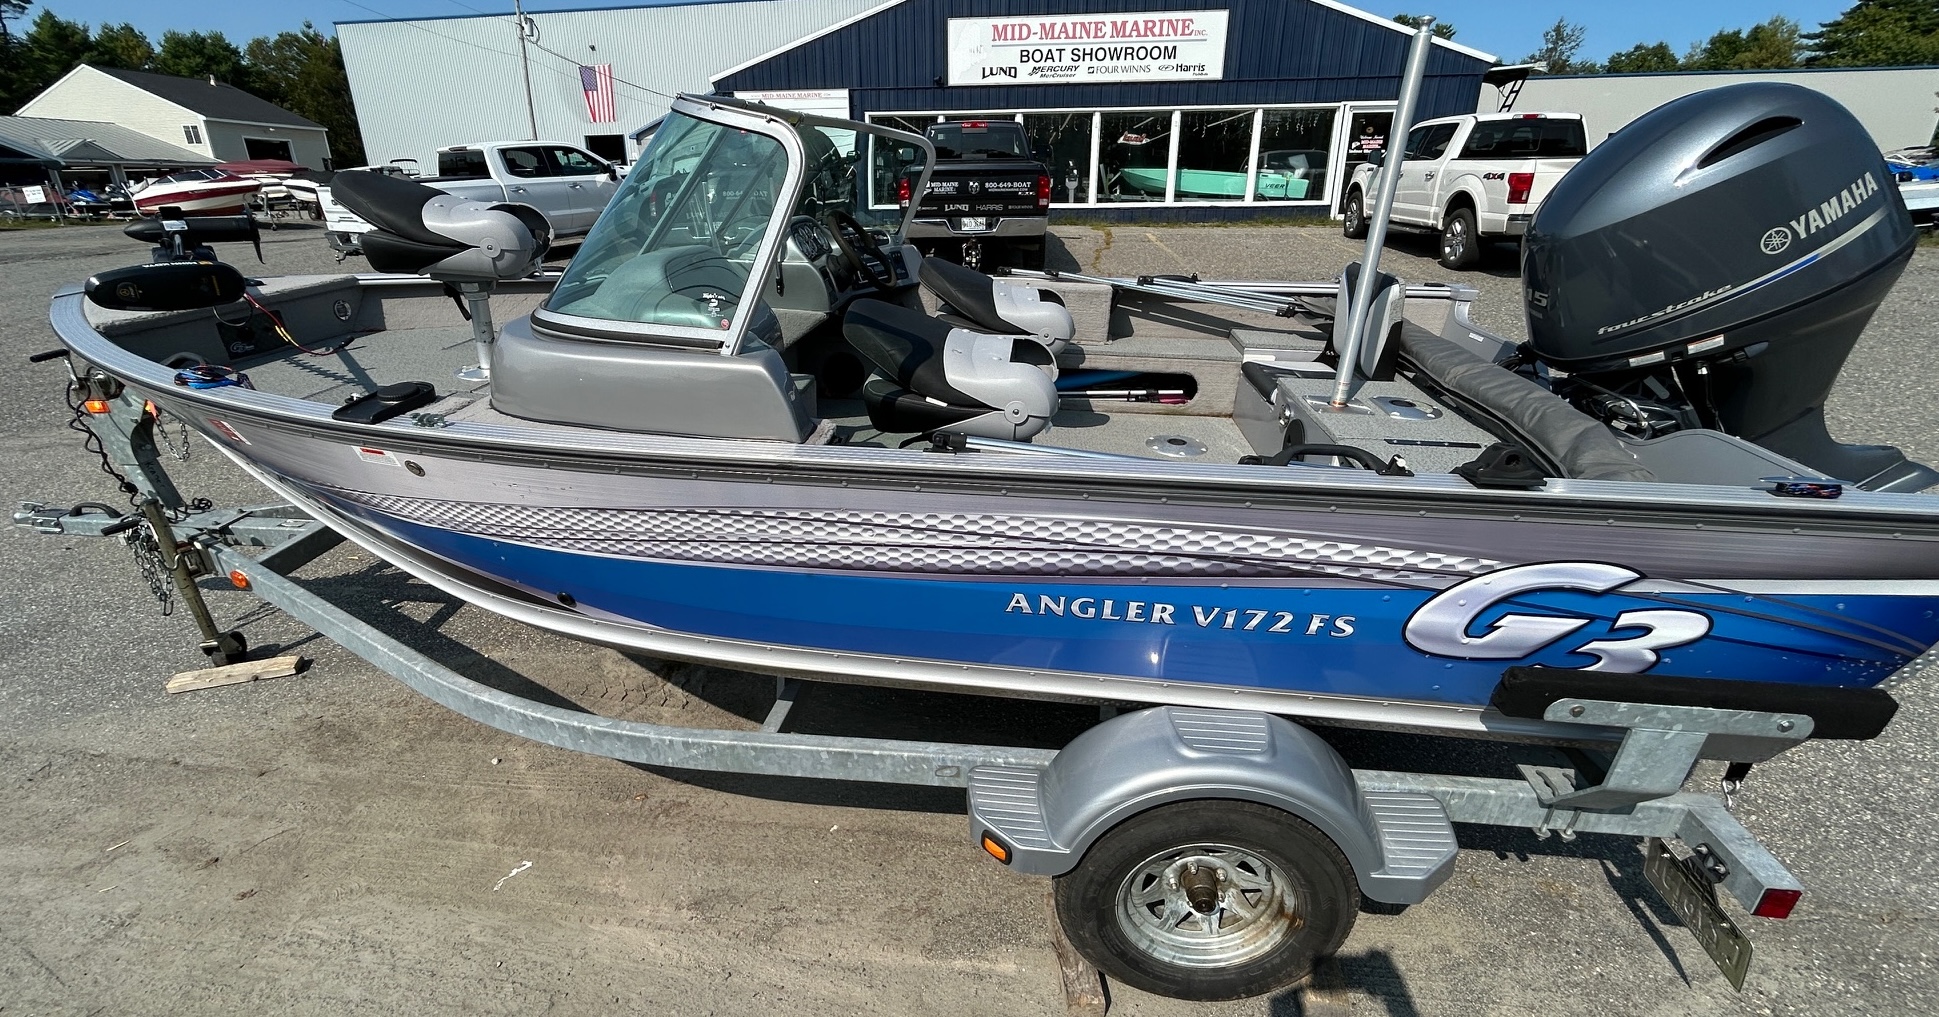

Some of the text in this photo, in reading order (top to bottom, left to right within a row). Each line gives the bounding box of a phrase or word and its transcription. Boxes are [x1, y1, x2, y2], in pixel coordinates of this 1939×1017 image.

[992, 21, 1107, 41] MID-MAINE
[1110, 18, 1194, 38] MARINE
[1019, 45, 1177, 63] BOAT SHOWROOM
[982, 63, 1205, 79] LUND MERCURY FOUR WINNS Harris
[944, 204, 969, 212] LUND
[1789, 171, 1879, 240] YAMAHA
[1005, 592, 1358, 639] ANGLER V172 FS
[1402, 559, 1715, 674] G3
